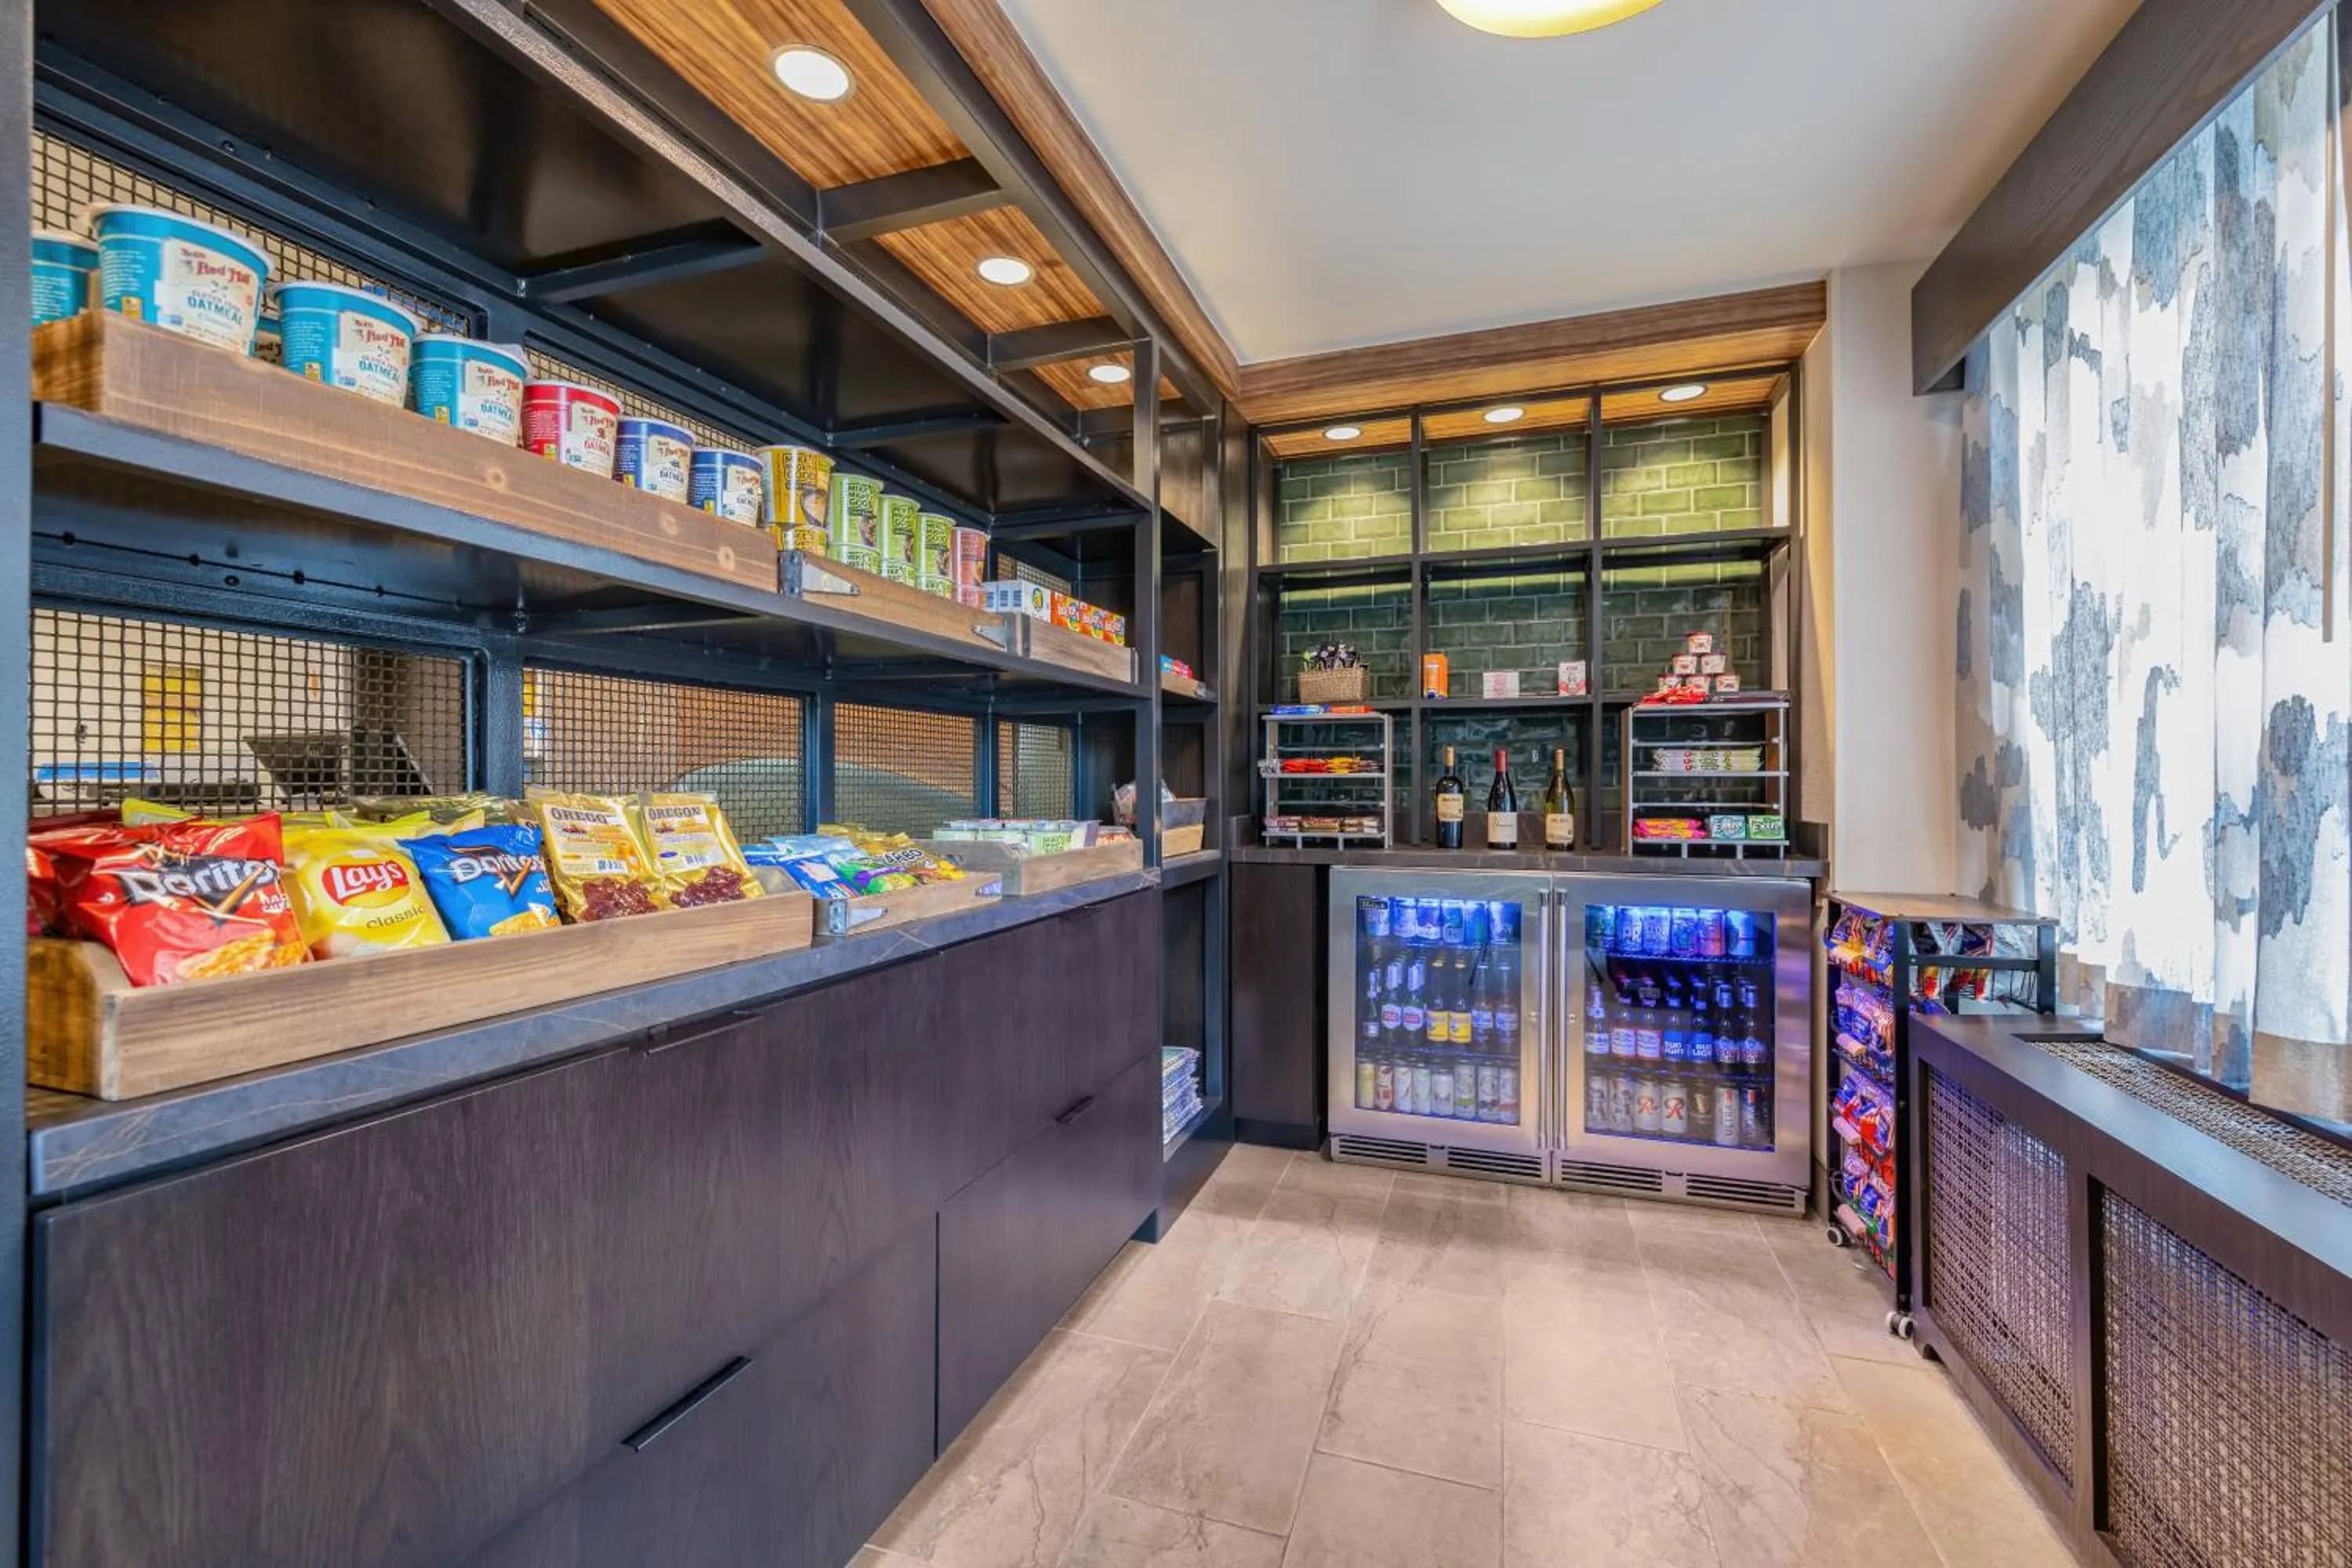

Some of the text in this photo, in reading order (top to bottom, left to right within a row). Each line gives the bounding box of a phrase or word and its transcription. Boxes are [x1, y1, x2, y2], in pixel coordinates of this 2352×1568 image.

[196, 260, 251, 285] Red Mill
[187, 296, 243, 325] OATMEAL
[366, 329, 390, 343] Red
[550, 808, 613, 825] OREGO
[331, 862, 402, 900] Lay's
[366, 906, 427, 929] classic
